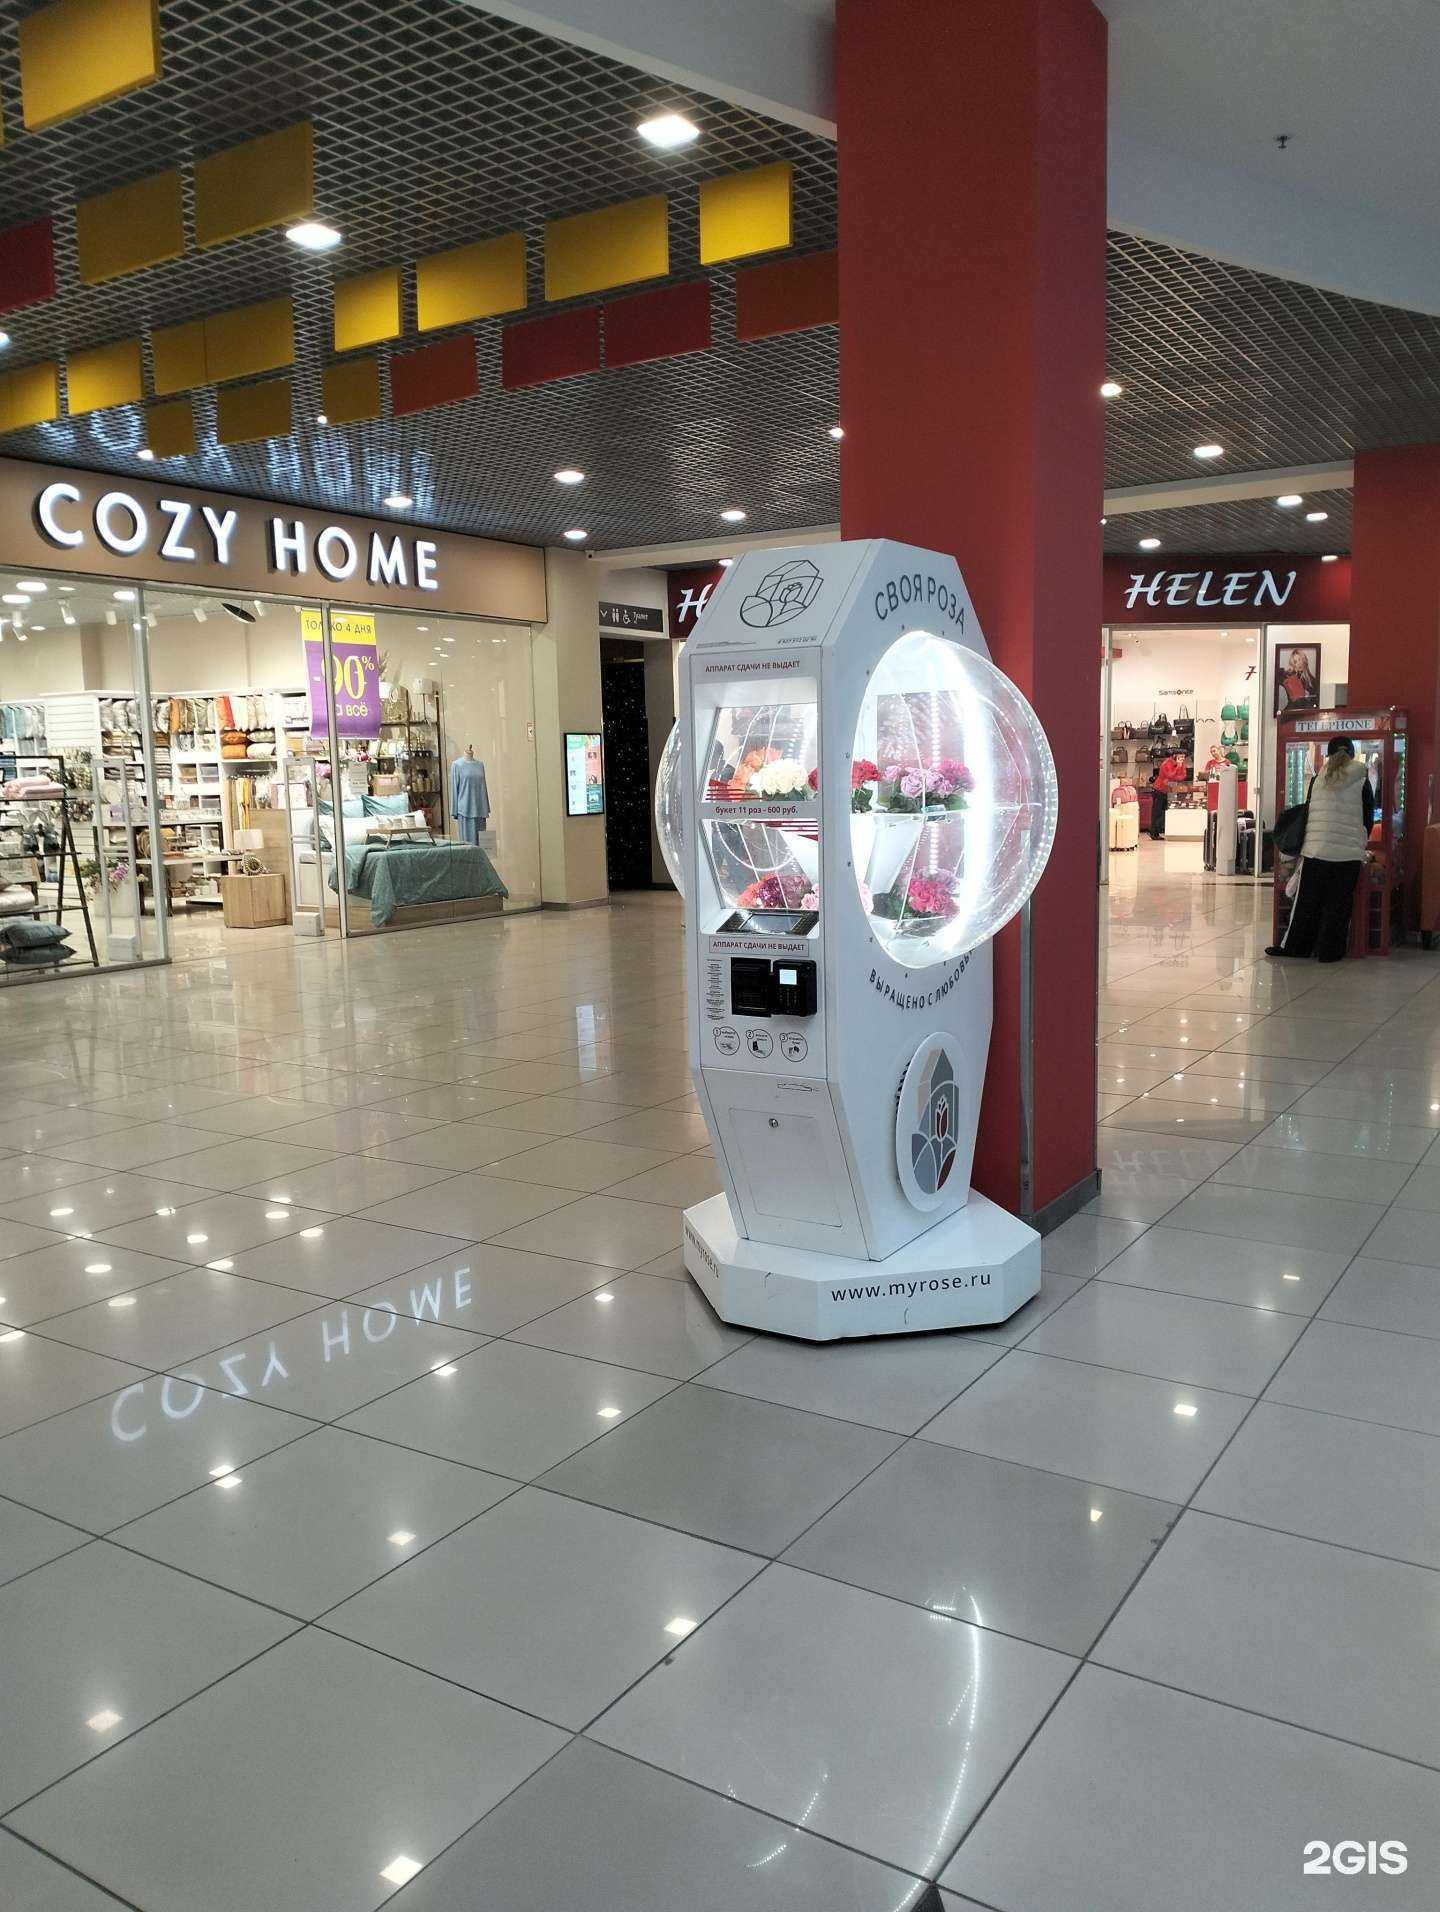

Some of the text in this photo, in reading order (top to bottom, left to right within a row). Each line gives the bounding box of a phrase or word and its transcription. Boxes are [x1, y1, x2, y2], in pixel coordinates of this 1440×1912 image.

[37, 482, 438, 590] COZY HOME
[1124, 569, 1297, 609] HELEN
[875, 574, 965, 635] СВОЯ РОЗА
[305, 619, 372, 635] ТОЛКО 4 ДНЯ
[705, 660, 800, 673] АППАРАТ СДАЧИ НЕ ВЫДАЕТ
[715, 806, 737, 815] букет
[748, 807, 761, 816] роз
[767, 806, 780, 814] 600
[782, 805, 798, 816] руб.
[713, 941, 742, 949] АППАРАТ
[869, 968, 925, 1010] ВЫРАЩЕНО
[831, 1273, 991, 1302] www.myrose.ru
